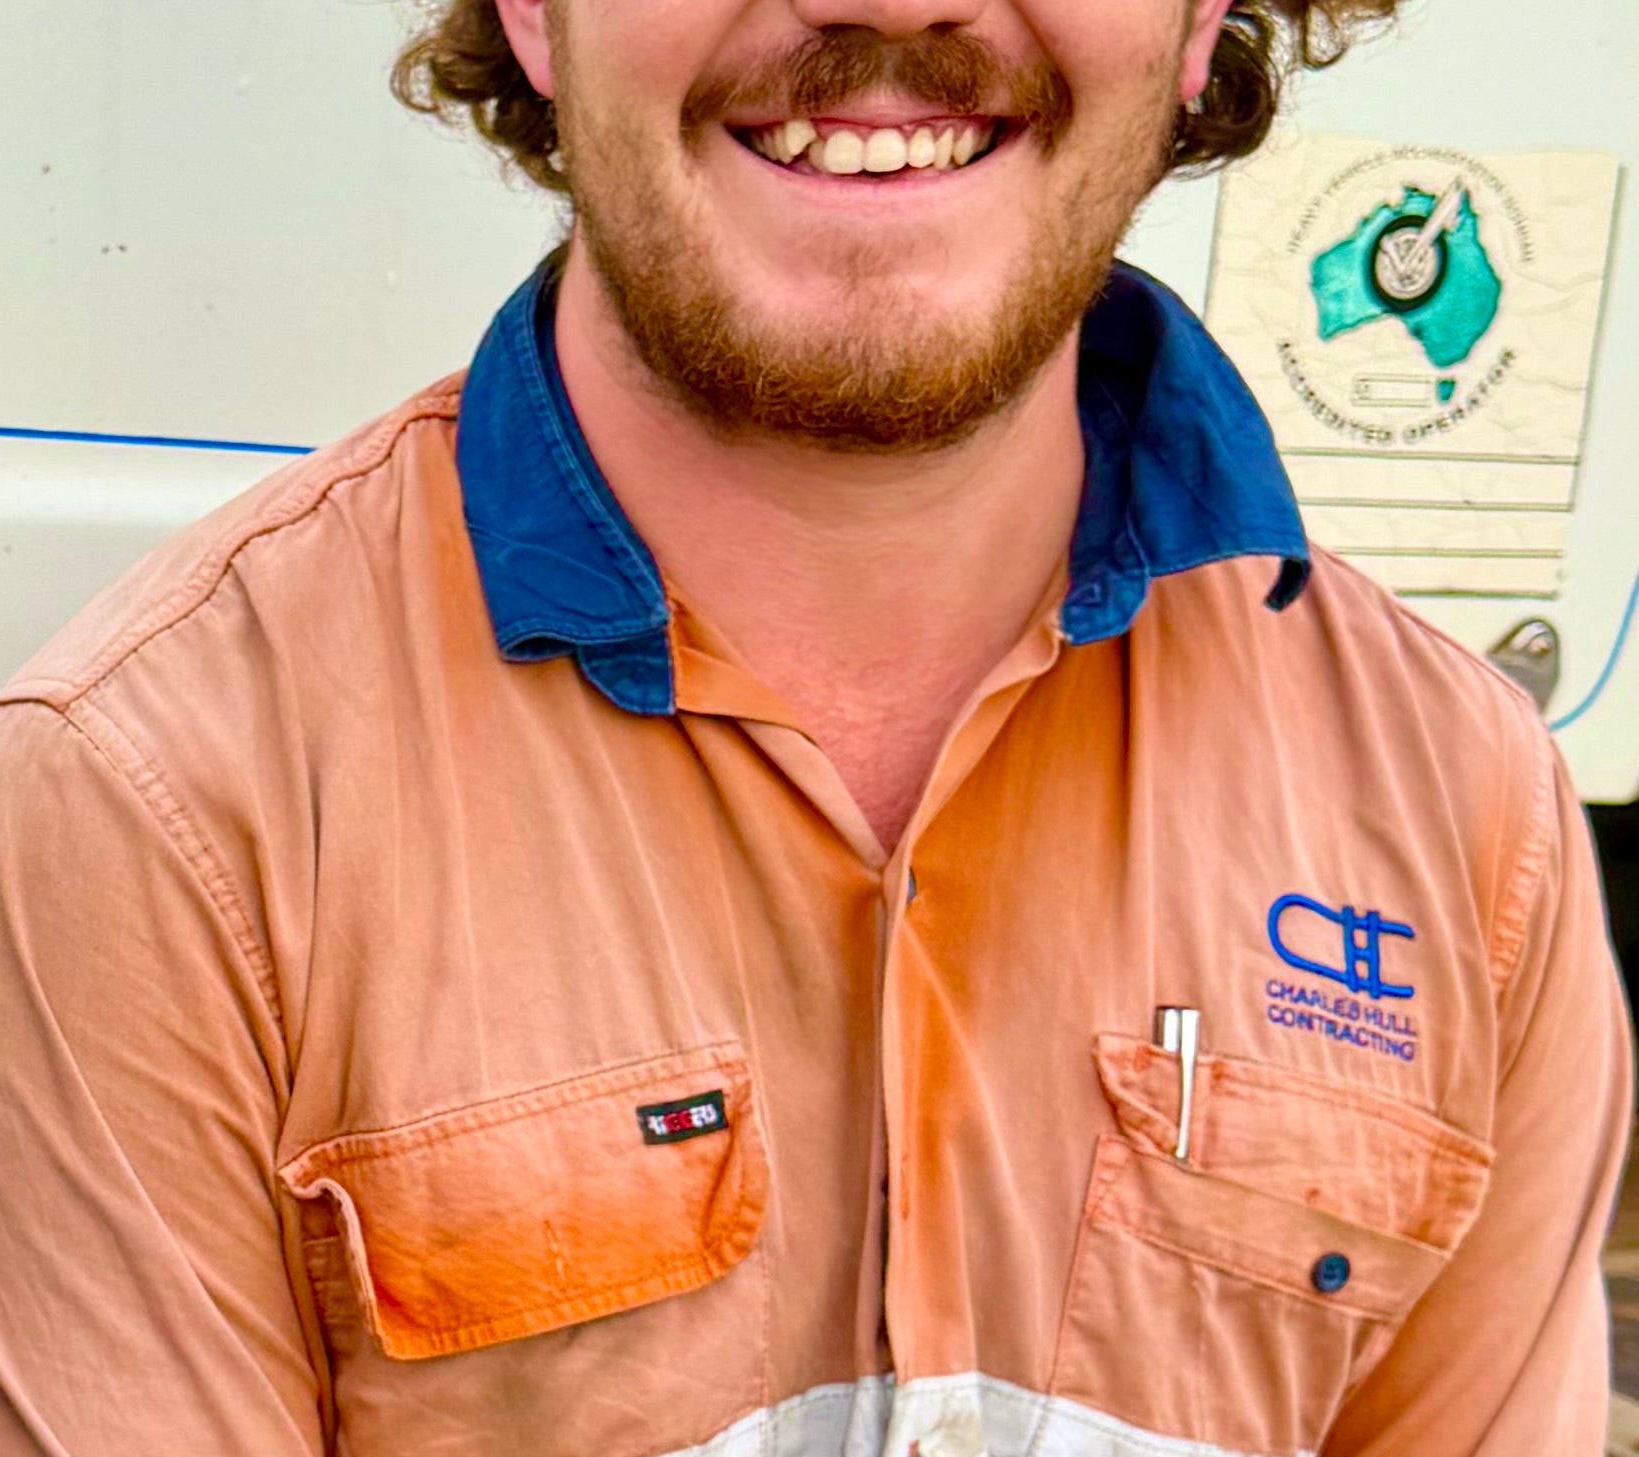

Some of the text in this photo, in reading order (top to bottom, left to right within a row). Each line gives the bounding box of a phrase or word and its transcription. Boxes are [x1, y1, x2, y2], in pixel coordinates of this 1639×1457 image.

[1265, 979, 1419, 1037] CHARLES HULL
[1267, 1004, 1416, 1061] CONTRACTING
